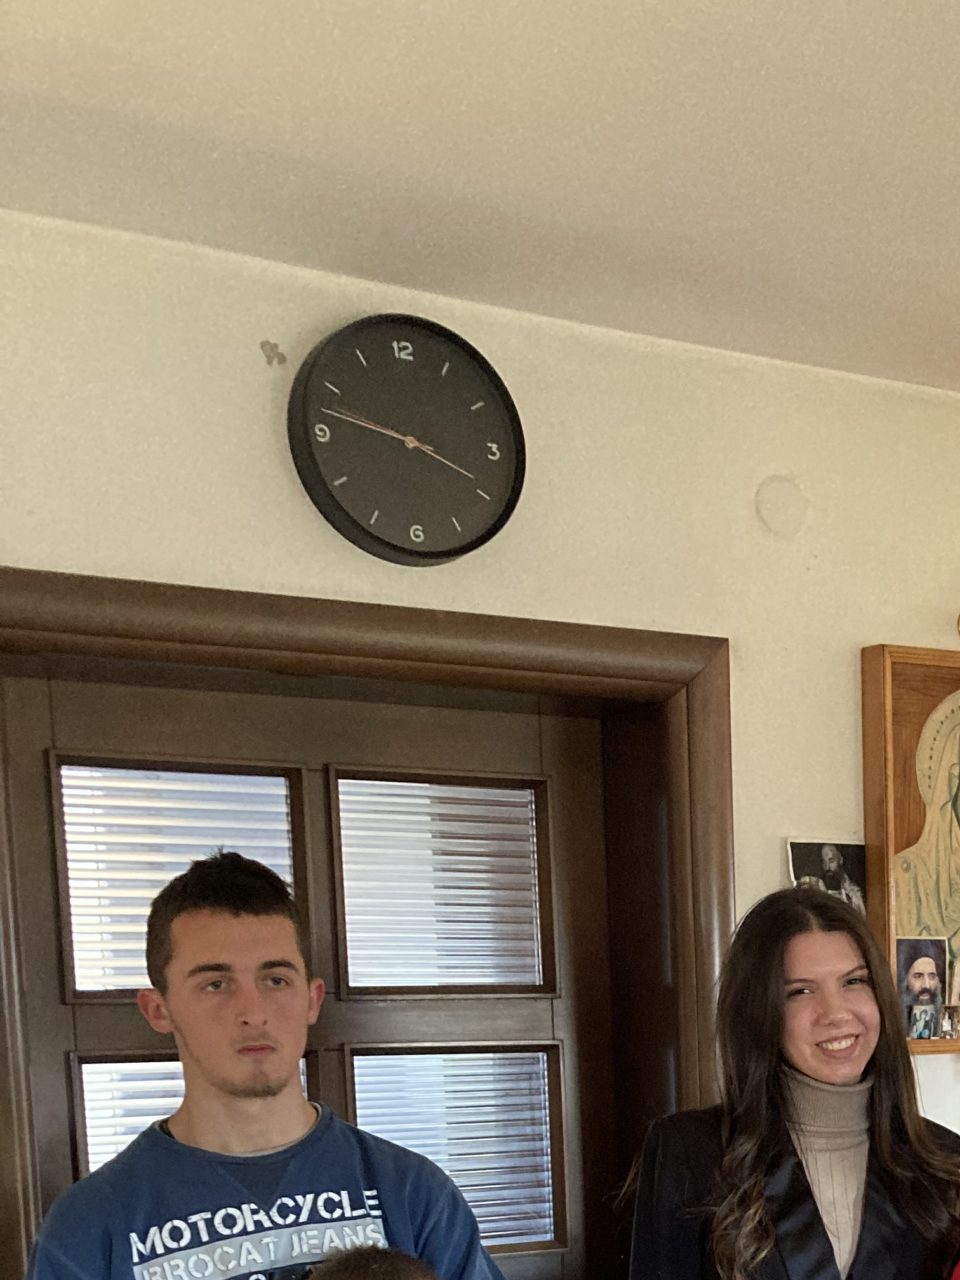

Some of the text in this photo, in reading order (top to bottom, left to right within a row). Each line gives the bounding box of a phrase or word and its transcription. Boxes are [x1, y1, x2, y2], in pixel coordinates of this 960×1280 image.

[392, 340, 414, 361] 12
[314, 424, 331, 443] 9
[486, 442, 501, 460] 3
[410, 525, 425, 542] 6
[130, 1190, 383, 1263] MOTORCYCLE
[291, 1223, 386, 1258] JEANS
